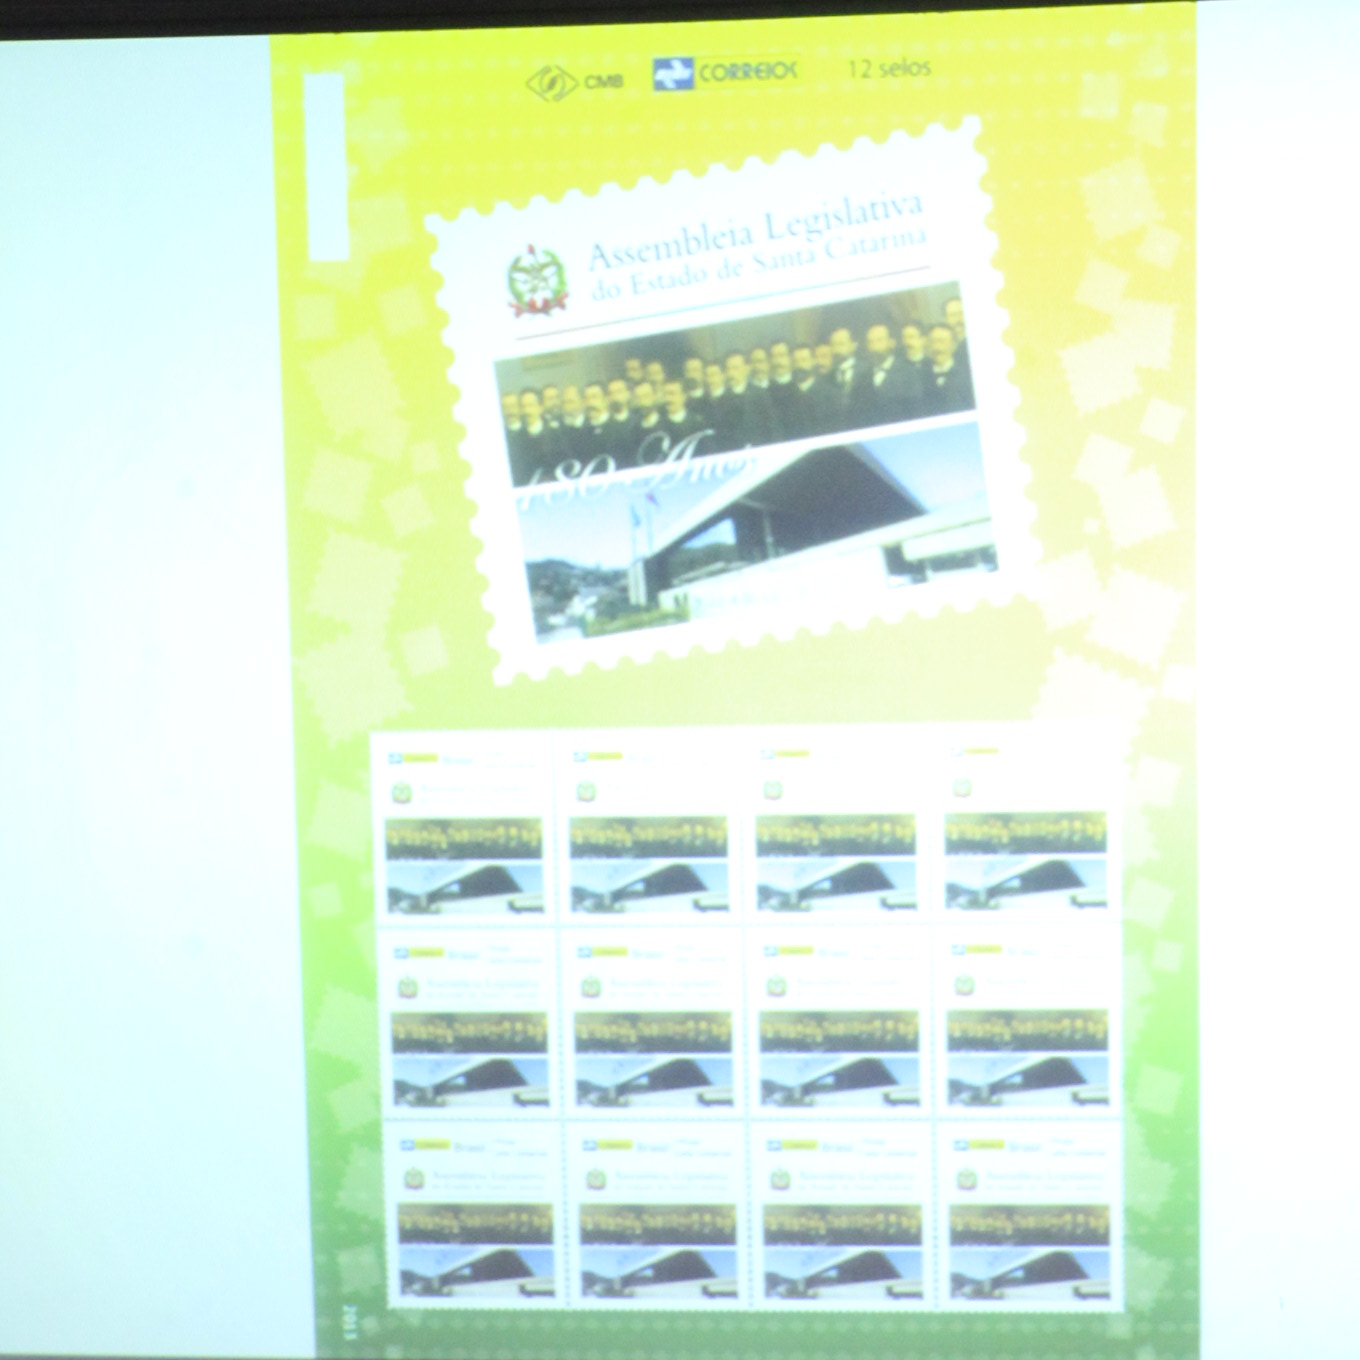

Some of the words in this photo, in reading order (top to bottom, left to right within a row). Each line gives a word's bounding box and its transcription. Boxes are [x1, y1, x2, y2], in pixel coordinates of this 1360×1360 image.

[584, 73, 625, 90] CMB
[849, 57, 872, 79] 12
[879, 56, 932, 78] selos
[588, 219, 753, 273] Assembleia
[764, 192, 924, 243] Legislativa
[592, 276, 621, 302] do
[630, 258, 708, 297] Estado
[716, 254, 744, 281] de
[752, 248, 817, 274] Santa
[824, 226, 928, 261] Catarina
